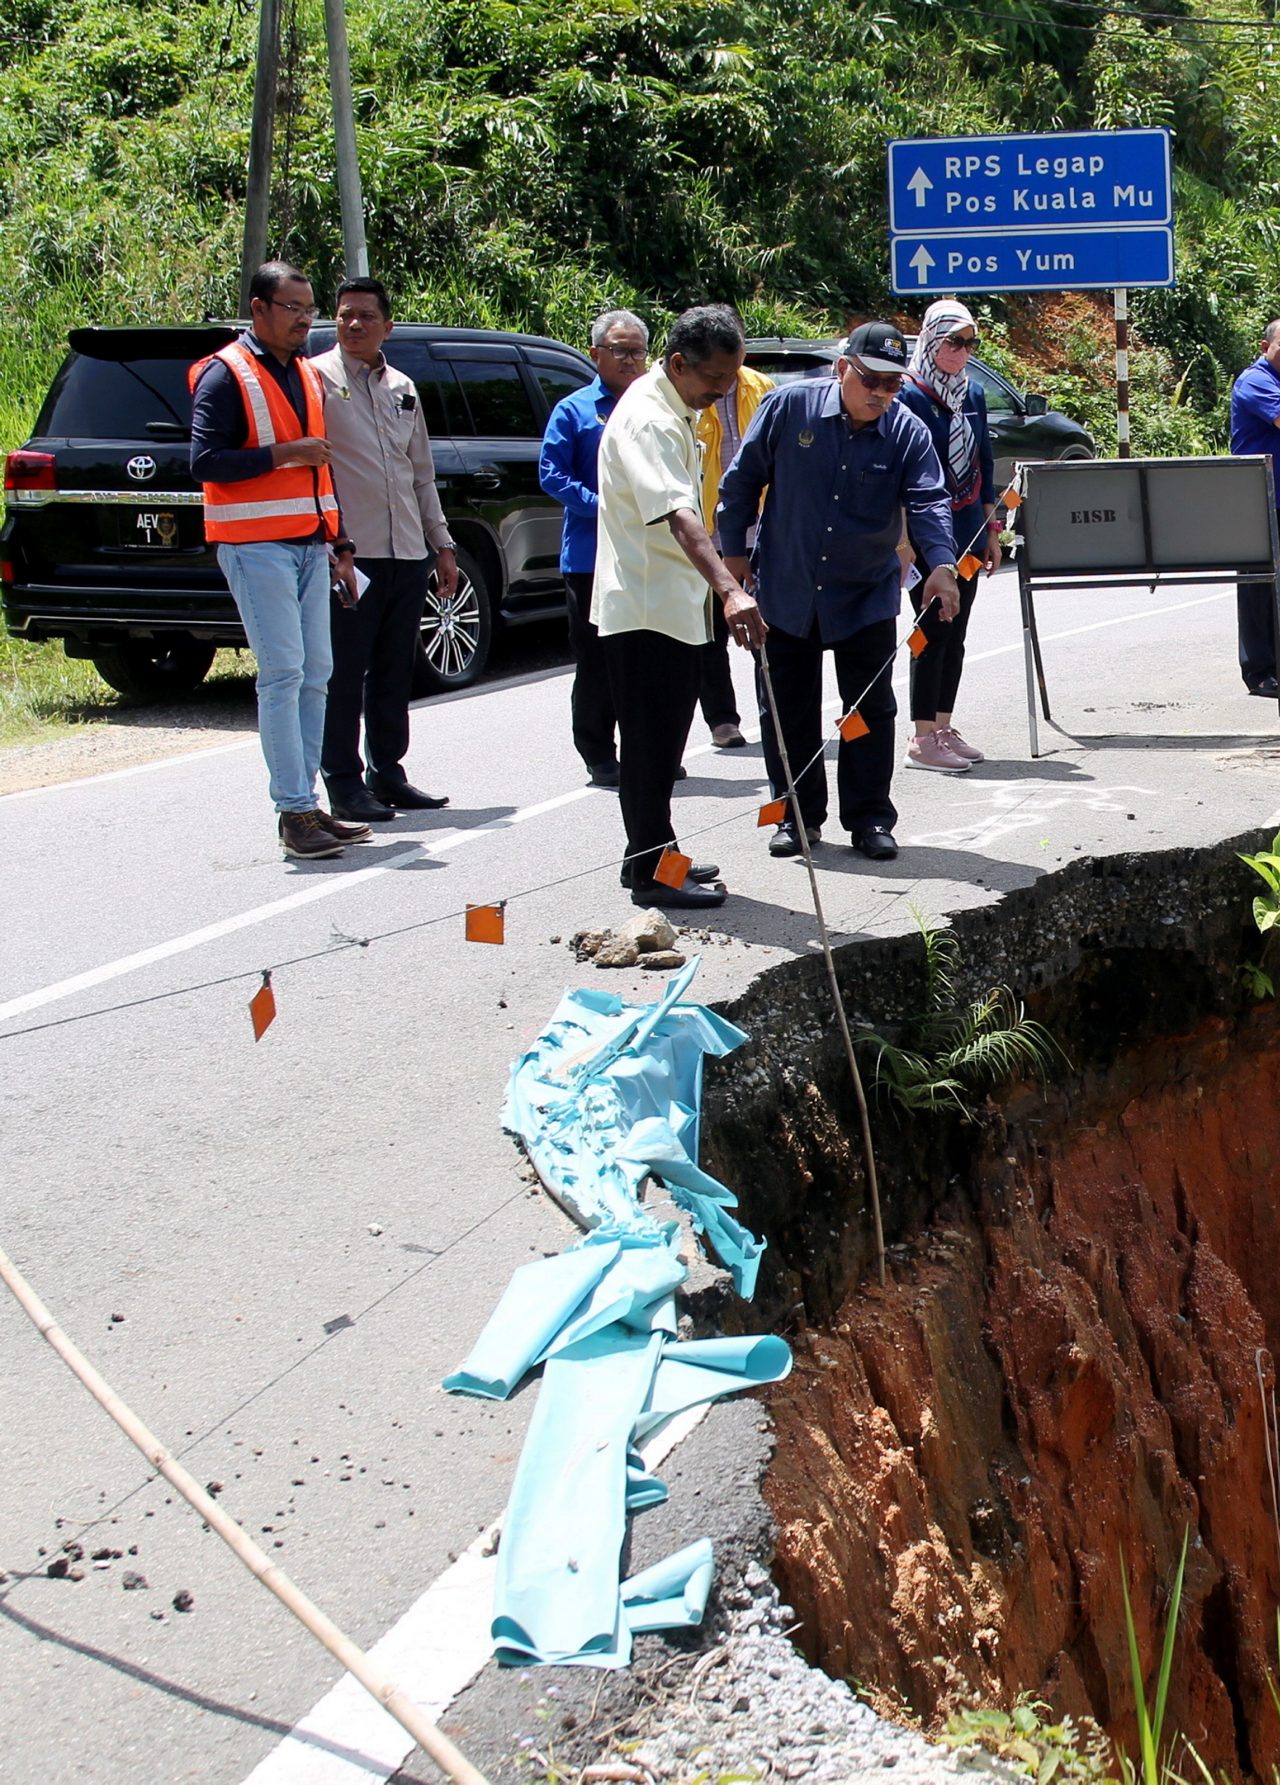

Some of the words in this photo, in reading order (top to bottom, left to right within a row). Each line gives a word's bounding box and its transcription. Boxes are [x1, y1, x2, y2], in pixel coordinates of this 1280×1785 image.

[945, 155, 1001, 179] RPS
[1018, 153, 1104, 178] Legap
[946, 192, 997, 214] Pos
[1013, 187, 1096, 211] Kuala
[1113, 185, 1153, 207] Mu
[948, 252, 998, 273] Pos
[1015, 249, 1075, 271] Yum
[136, 513, 159, 528] AEV
[1071, 509, 1116, 524] EISB
[144, 529, 151, 543] 1
